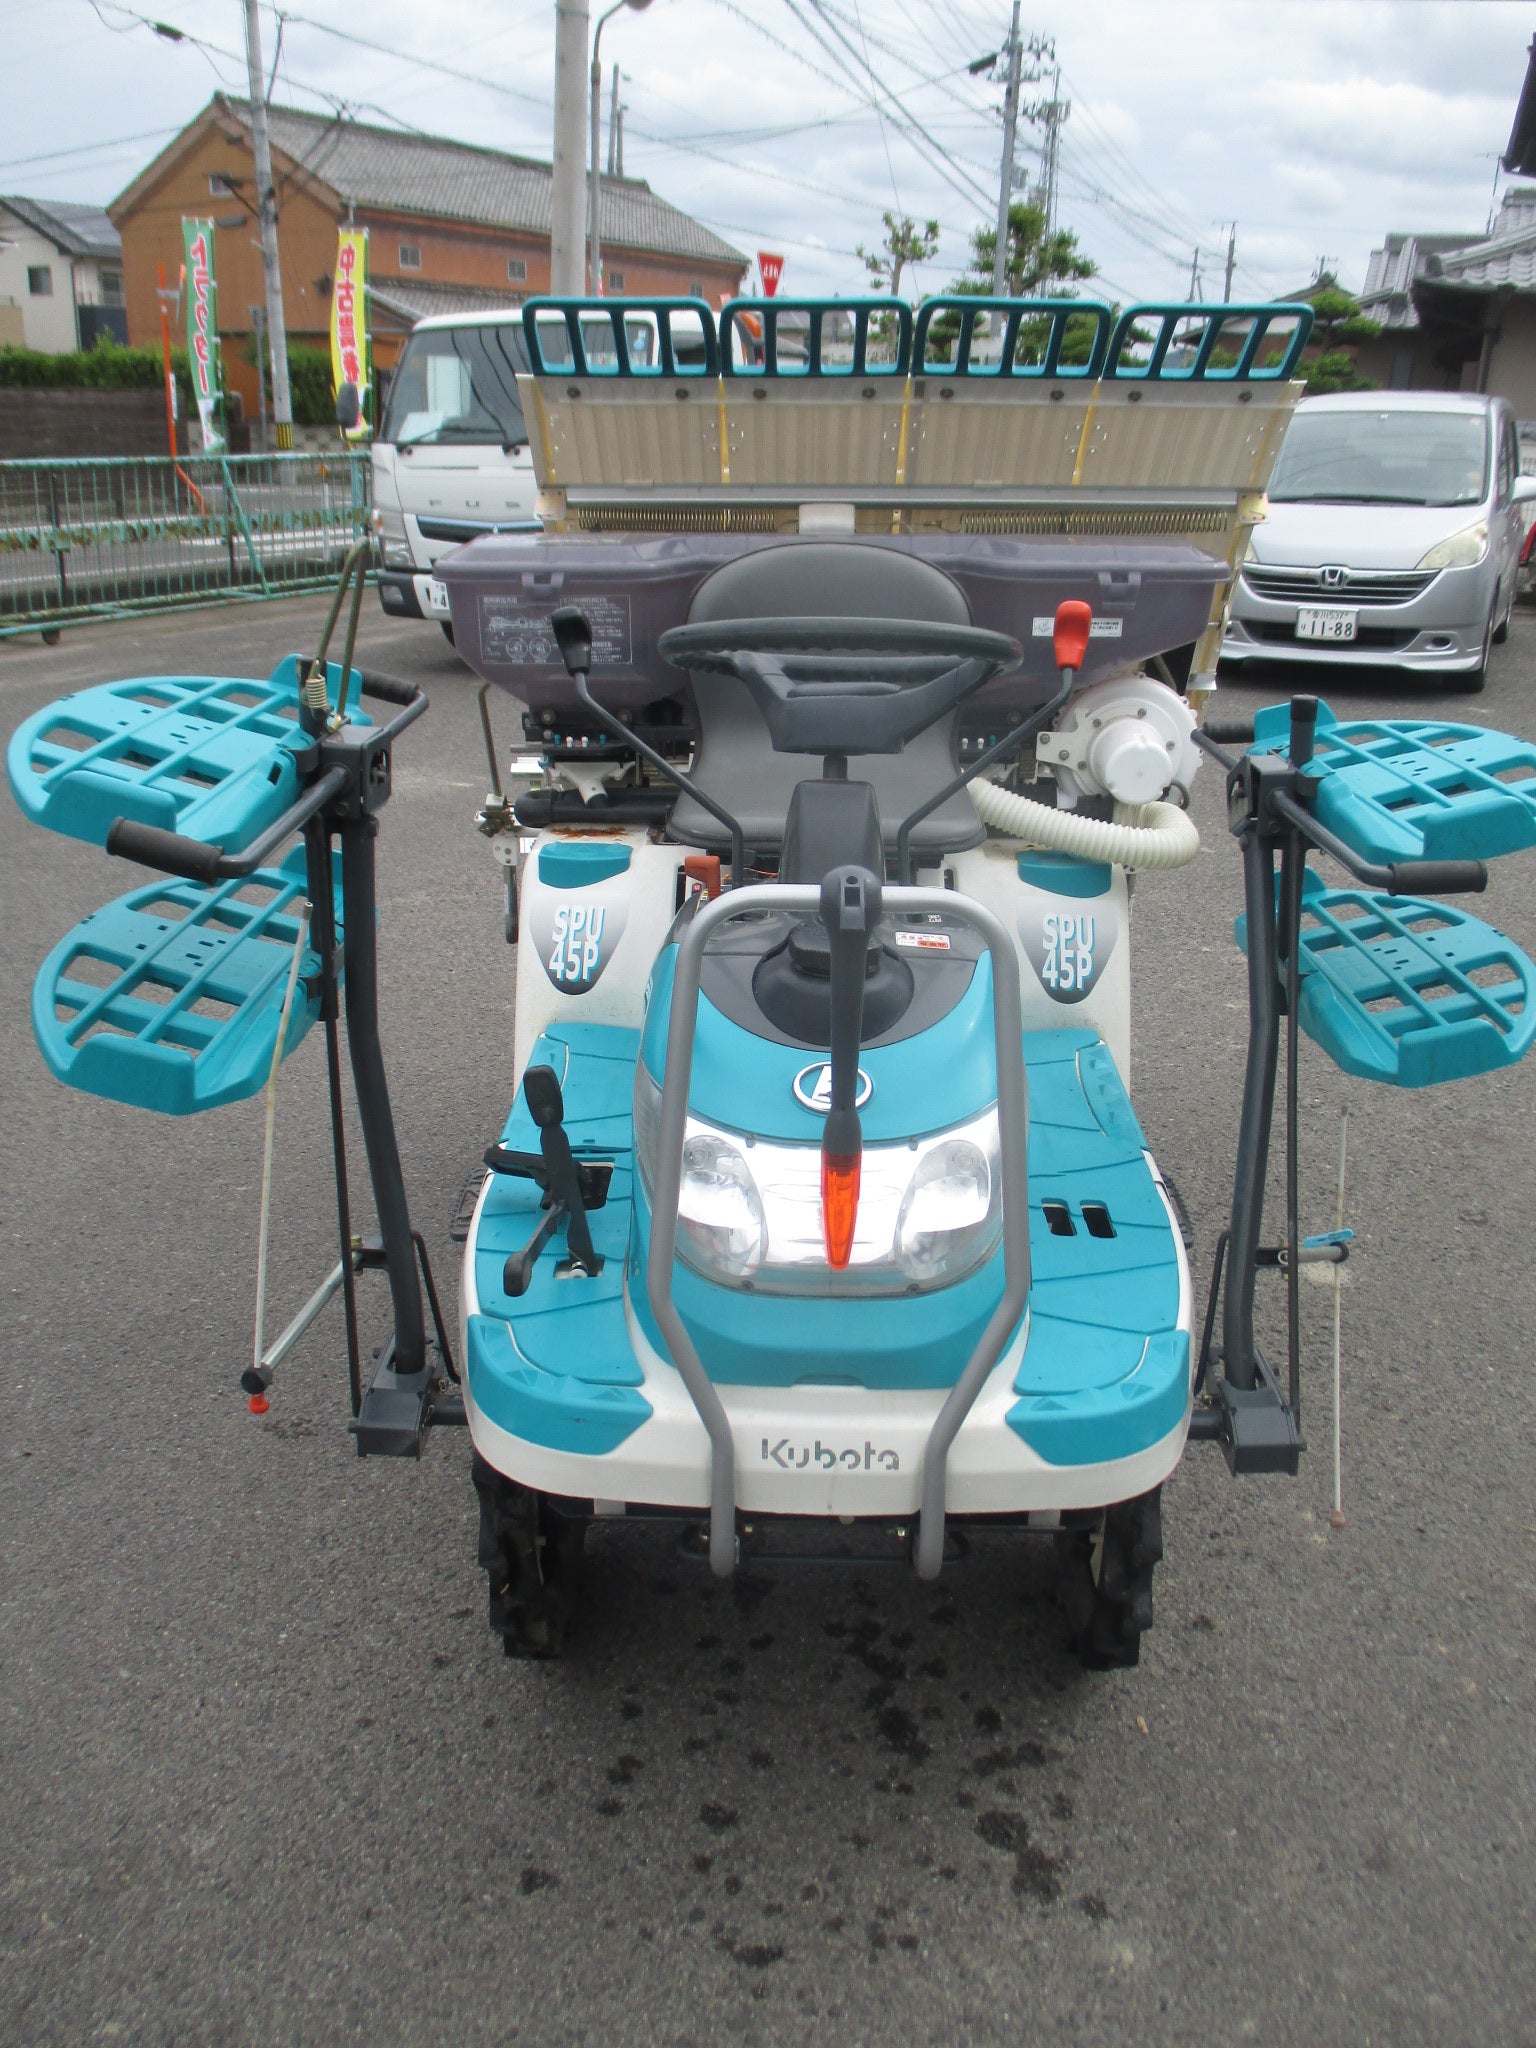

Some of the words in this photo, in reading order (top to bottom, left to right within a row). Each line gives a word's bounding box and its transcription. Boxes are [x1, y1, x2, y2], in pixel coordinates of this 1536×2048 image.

[428, 499, 520, 508] FUS
[1311, 620, 1353, 637] 11-88
[552, 904, 606, 942] SPU
[1042, 913, 1095, 951] SPU
[549, 940, 601, 982] 45P
[1042, 949, 1094, 992] 45P
[761, 1438, 900, 1470] Kubota
